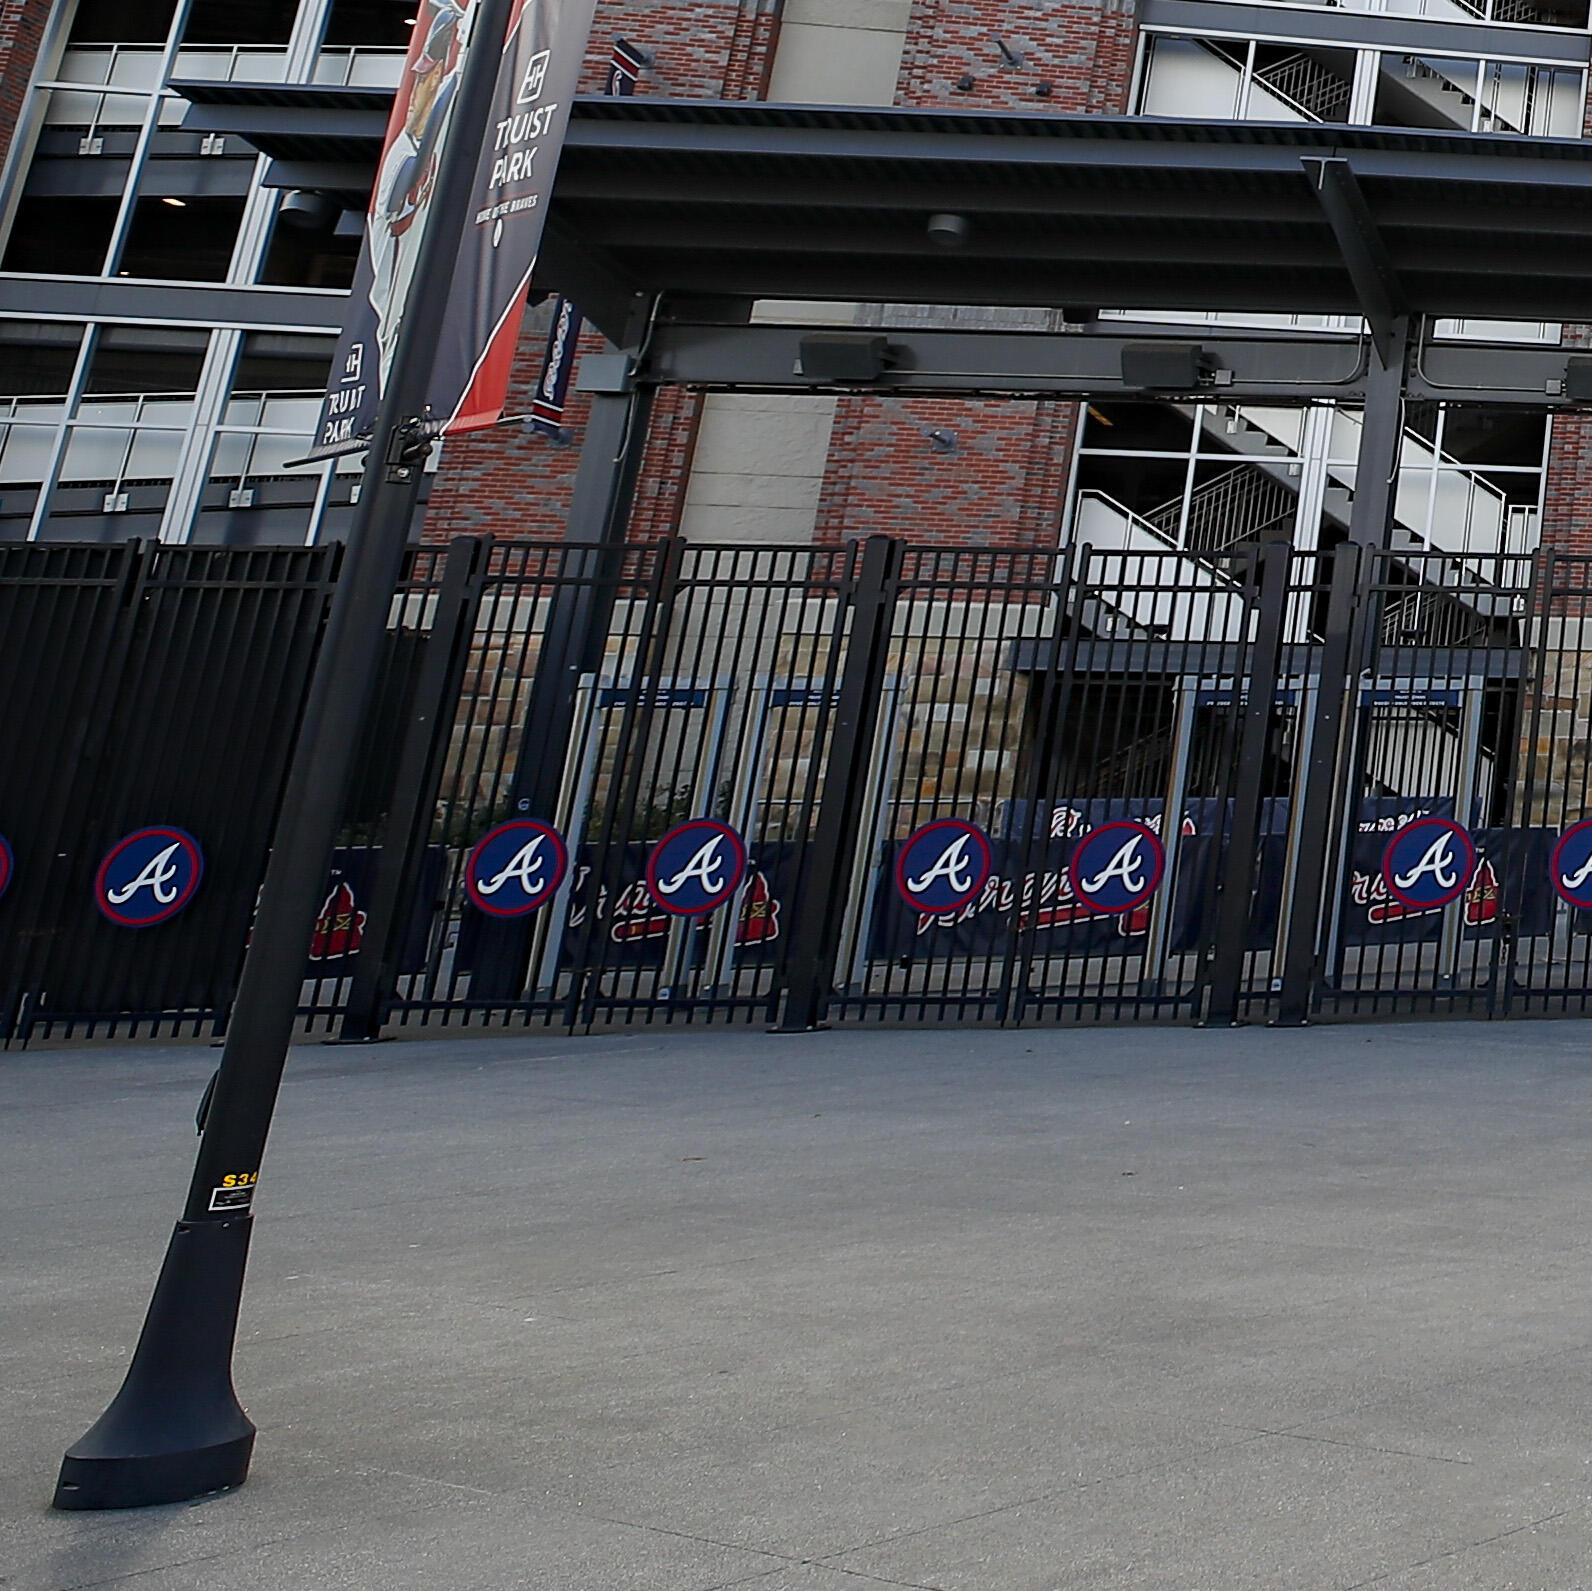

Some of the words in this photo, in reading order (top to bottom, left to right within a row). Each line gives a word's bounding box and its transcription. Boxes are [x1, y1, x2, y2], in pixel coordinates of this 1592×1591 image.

[107, 842, 180, 904] A
[477, 834, 546, 894] A
[658, 833, 724, 894] A
[907, 833, 972, 892] A
[1081, 833, 1145, 893] A
[1394, 830, 1457, 888] A
